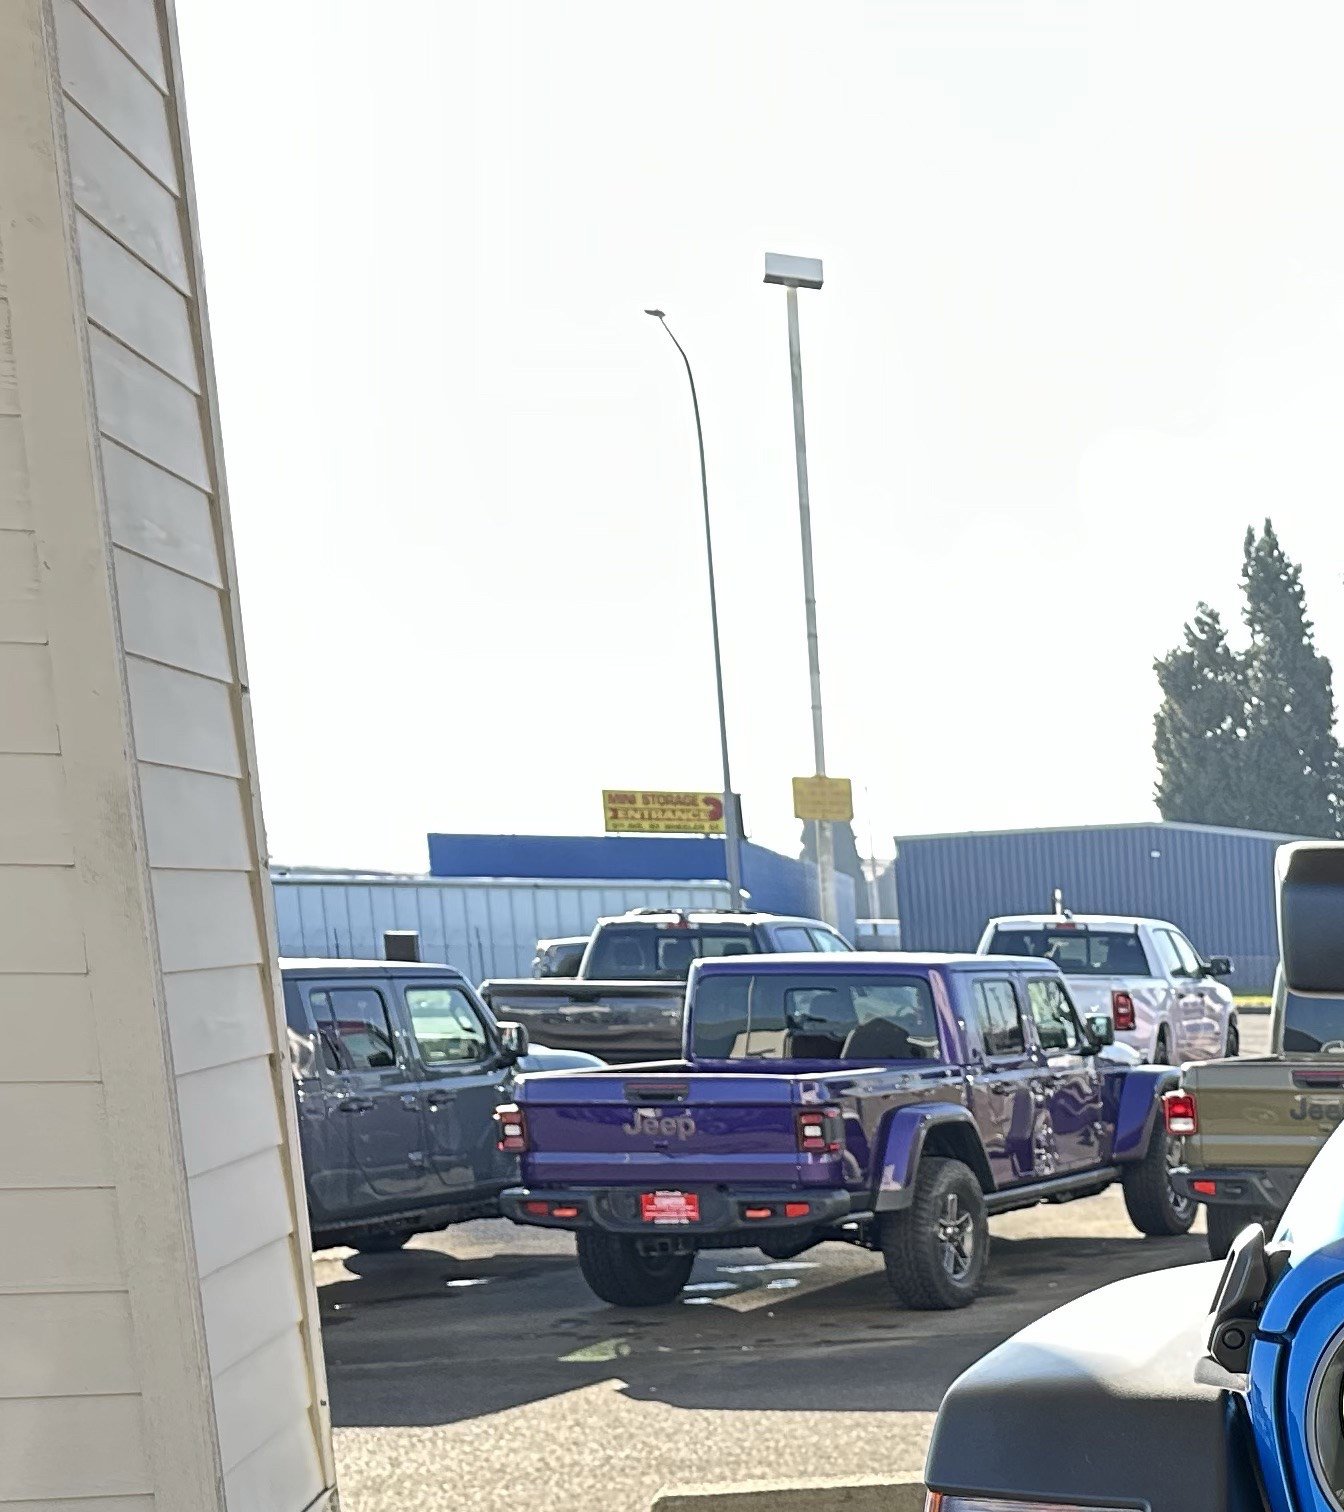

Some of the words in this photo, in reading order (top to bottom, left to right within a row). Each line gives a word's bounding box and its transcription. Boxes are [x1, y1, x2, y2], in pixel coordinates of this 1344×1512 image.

[641, 793, 699, 806] STORAGE
[617, 807, 711, 820] ENTRANCE
[1289, 1097, 1344, 1121] Jee
[622, 1108, 696, 1141] Jeep
